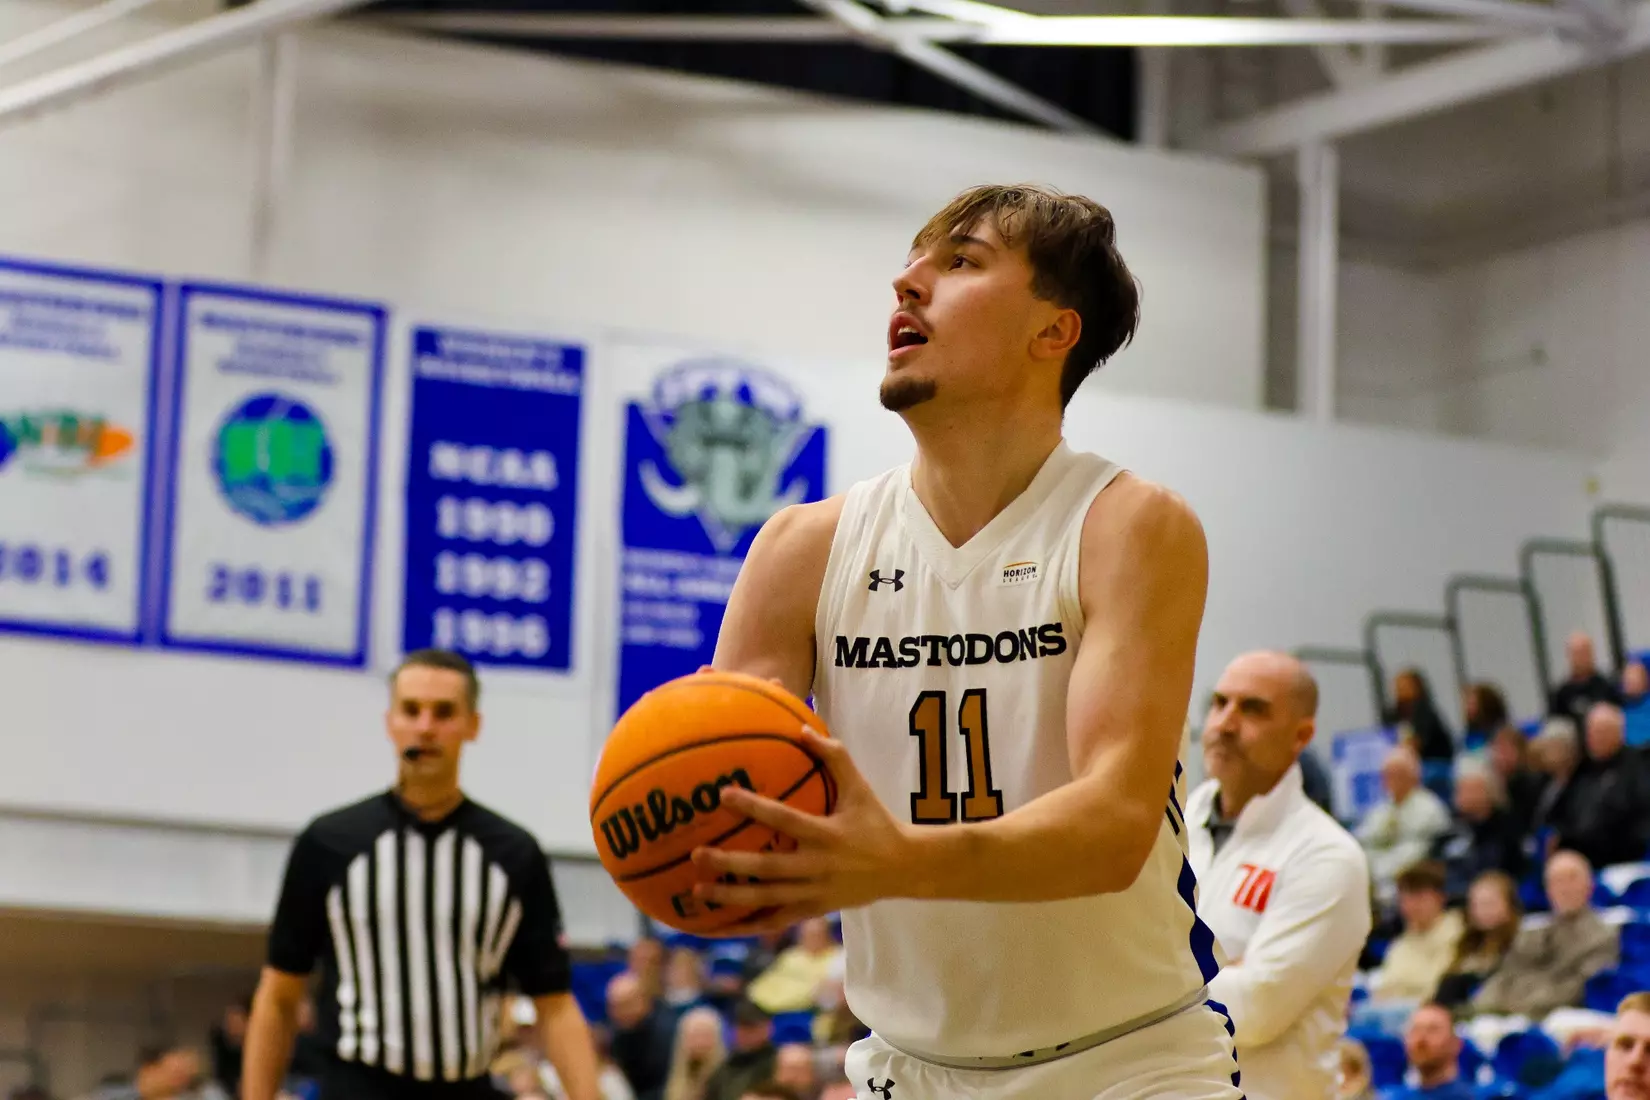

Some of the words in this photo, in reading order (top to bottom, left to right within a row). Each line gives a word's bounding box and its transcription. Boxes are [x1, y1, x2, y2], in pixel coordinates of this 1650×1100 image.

[429, 441, 559, 490] NCAA
[206, 563, 323, 615] 2011
[1003, 566, 1037, 577] HORIZON
[834, 622, 1067, 669] MASTODONS
[908, 688, 1004, 825] 11
[601, 768, 756, 859] Wilson
